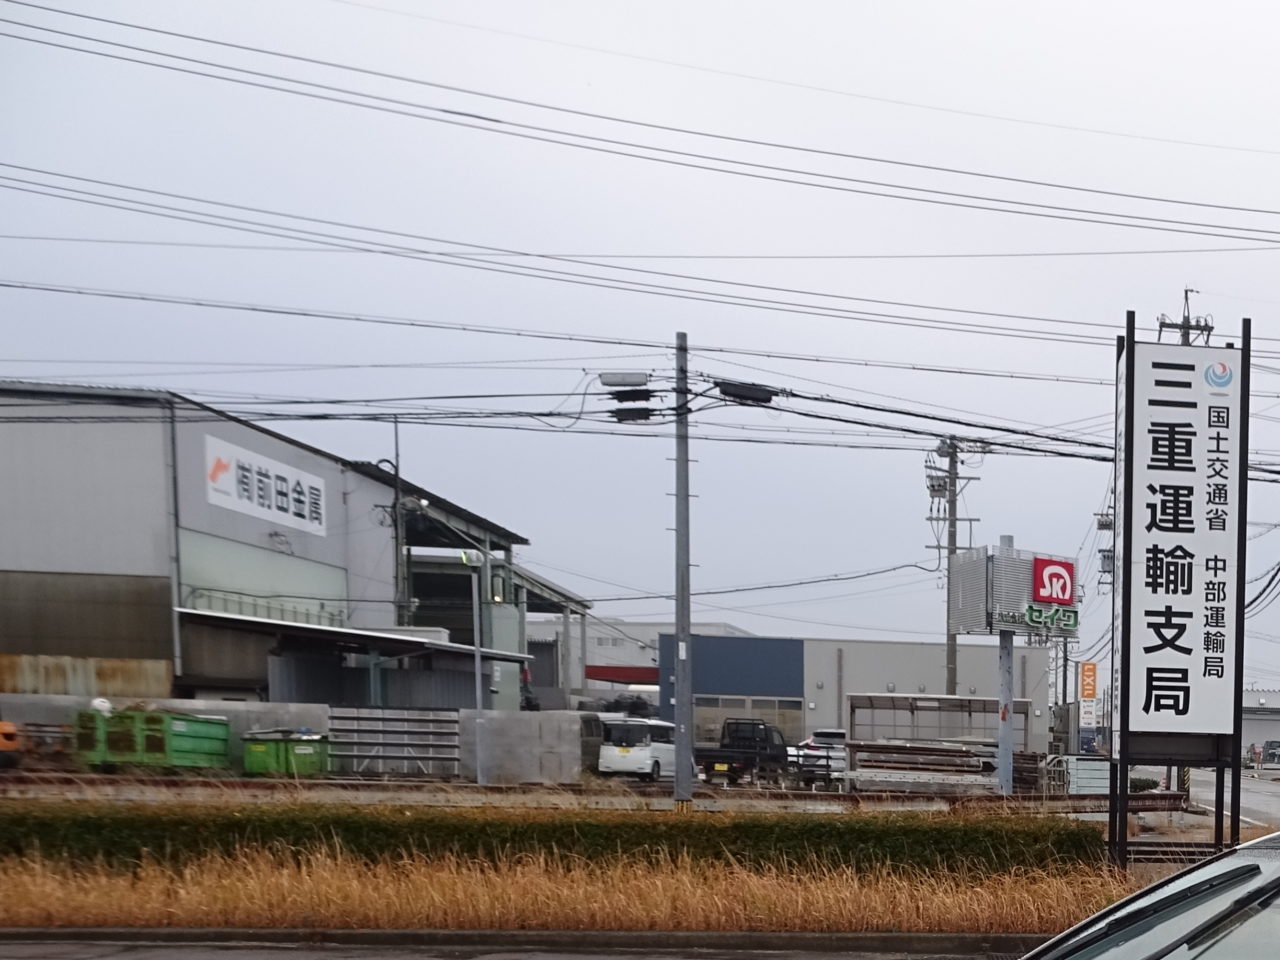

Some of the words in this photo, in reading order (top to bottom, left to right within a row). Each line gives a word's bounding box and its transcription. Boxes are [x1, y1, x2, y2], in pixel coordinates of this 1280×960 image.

[1205, 405, 1230, 532] 国土交通省
[1142, 361, 1198, 716] 三重運輸支局
[1203, 555, 1227, 679] 中部運輸局
[1083, 665, 1095, 696] LIXIL
